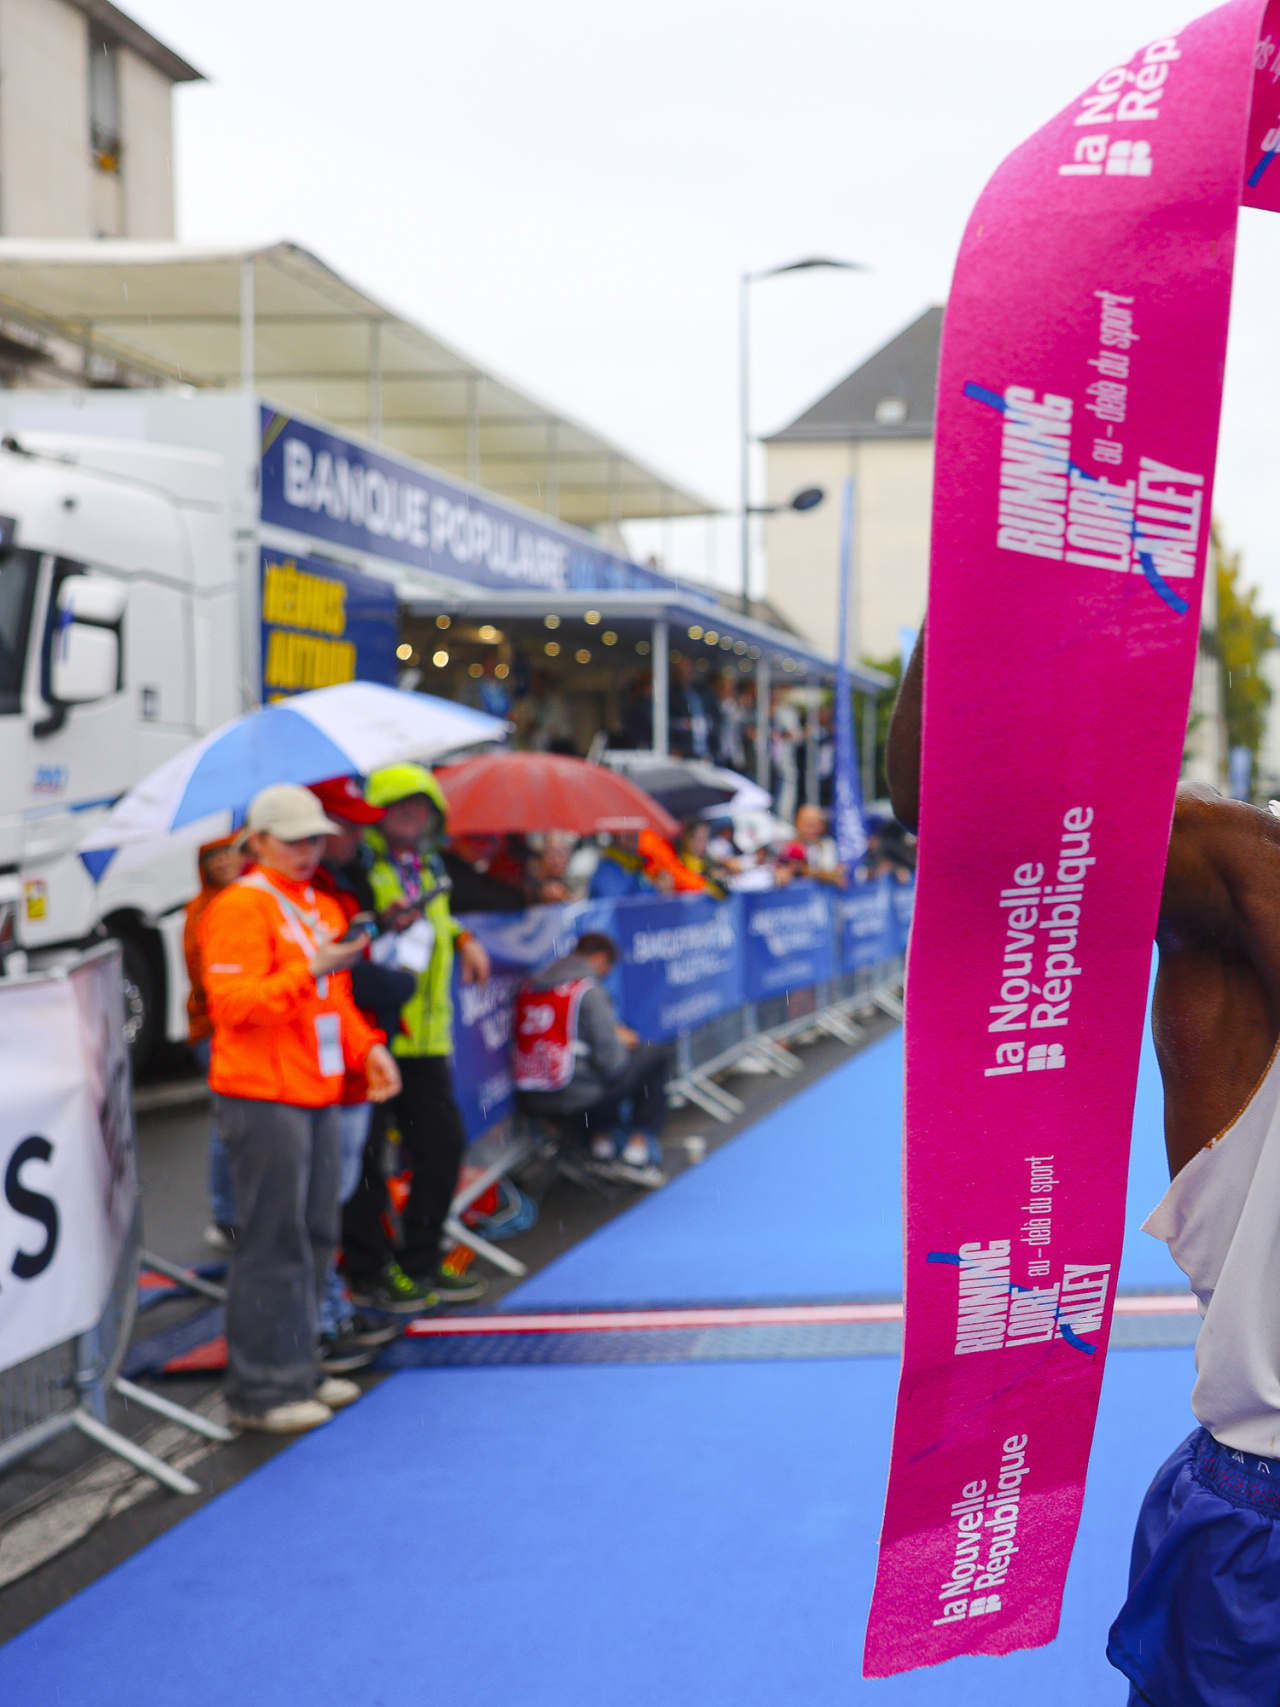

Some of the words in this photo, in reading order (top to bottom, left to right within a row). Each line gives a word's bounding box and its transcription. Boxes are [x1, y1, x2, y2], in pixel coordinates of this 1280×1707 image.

[1059, 134, 1110, 176] la
[1087, 350, 1130, 379] du
[1094, 290, 1140, 349] sport
[282, 437, 431, 550] BANQUE
[430, 495, 569, 590] POPULAIRE
[996, 385, 1073, 561] RUNNING
[1131, 456, 1205, 578] VALLEY
[1064, 469, 1137, 573] LOIRE
[988, 862, 1045, 1033] Nouvelle
[1030, 806, 1096, 1029] République
[984, 1041, 1025, 1077] la
[1021, 1196, 1053, 1214] du
[1025, 1154, 1060, 1193] sport
[954, 1239, 1011, 1355] RUNNING
[1005, 1281, 1061, 1348] LOIRE
[1054, 1263, 1111, 1340] VALLEY
[938, 1479, 987, 1600] Nouvelle
[974, 1433, 1031, 1591] République
[932, 1598, 968, 1628] la
